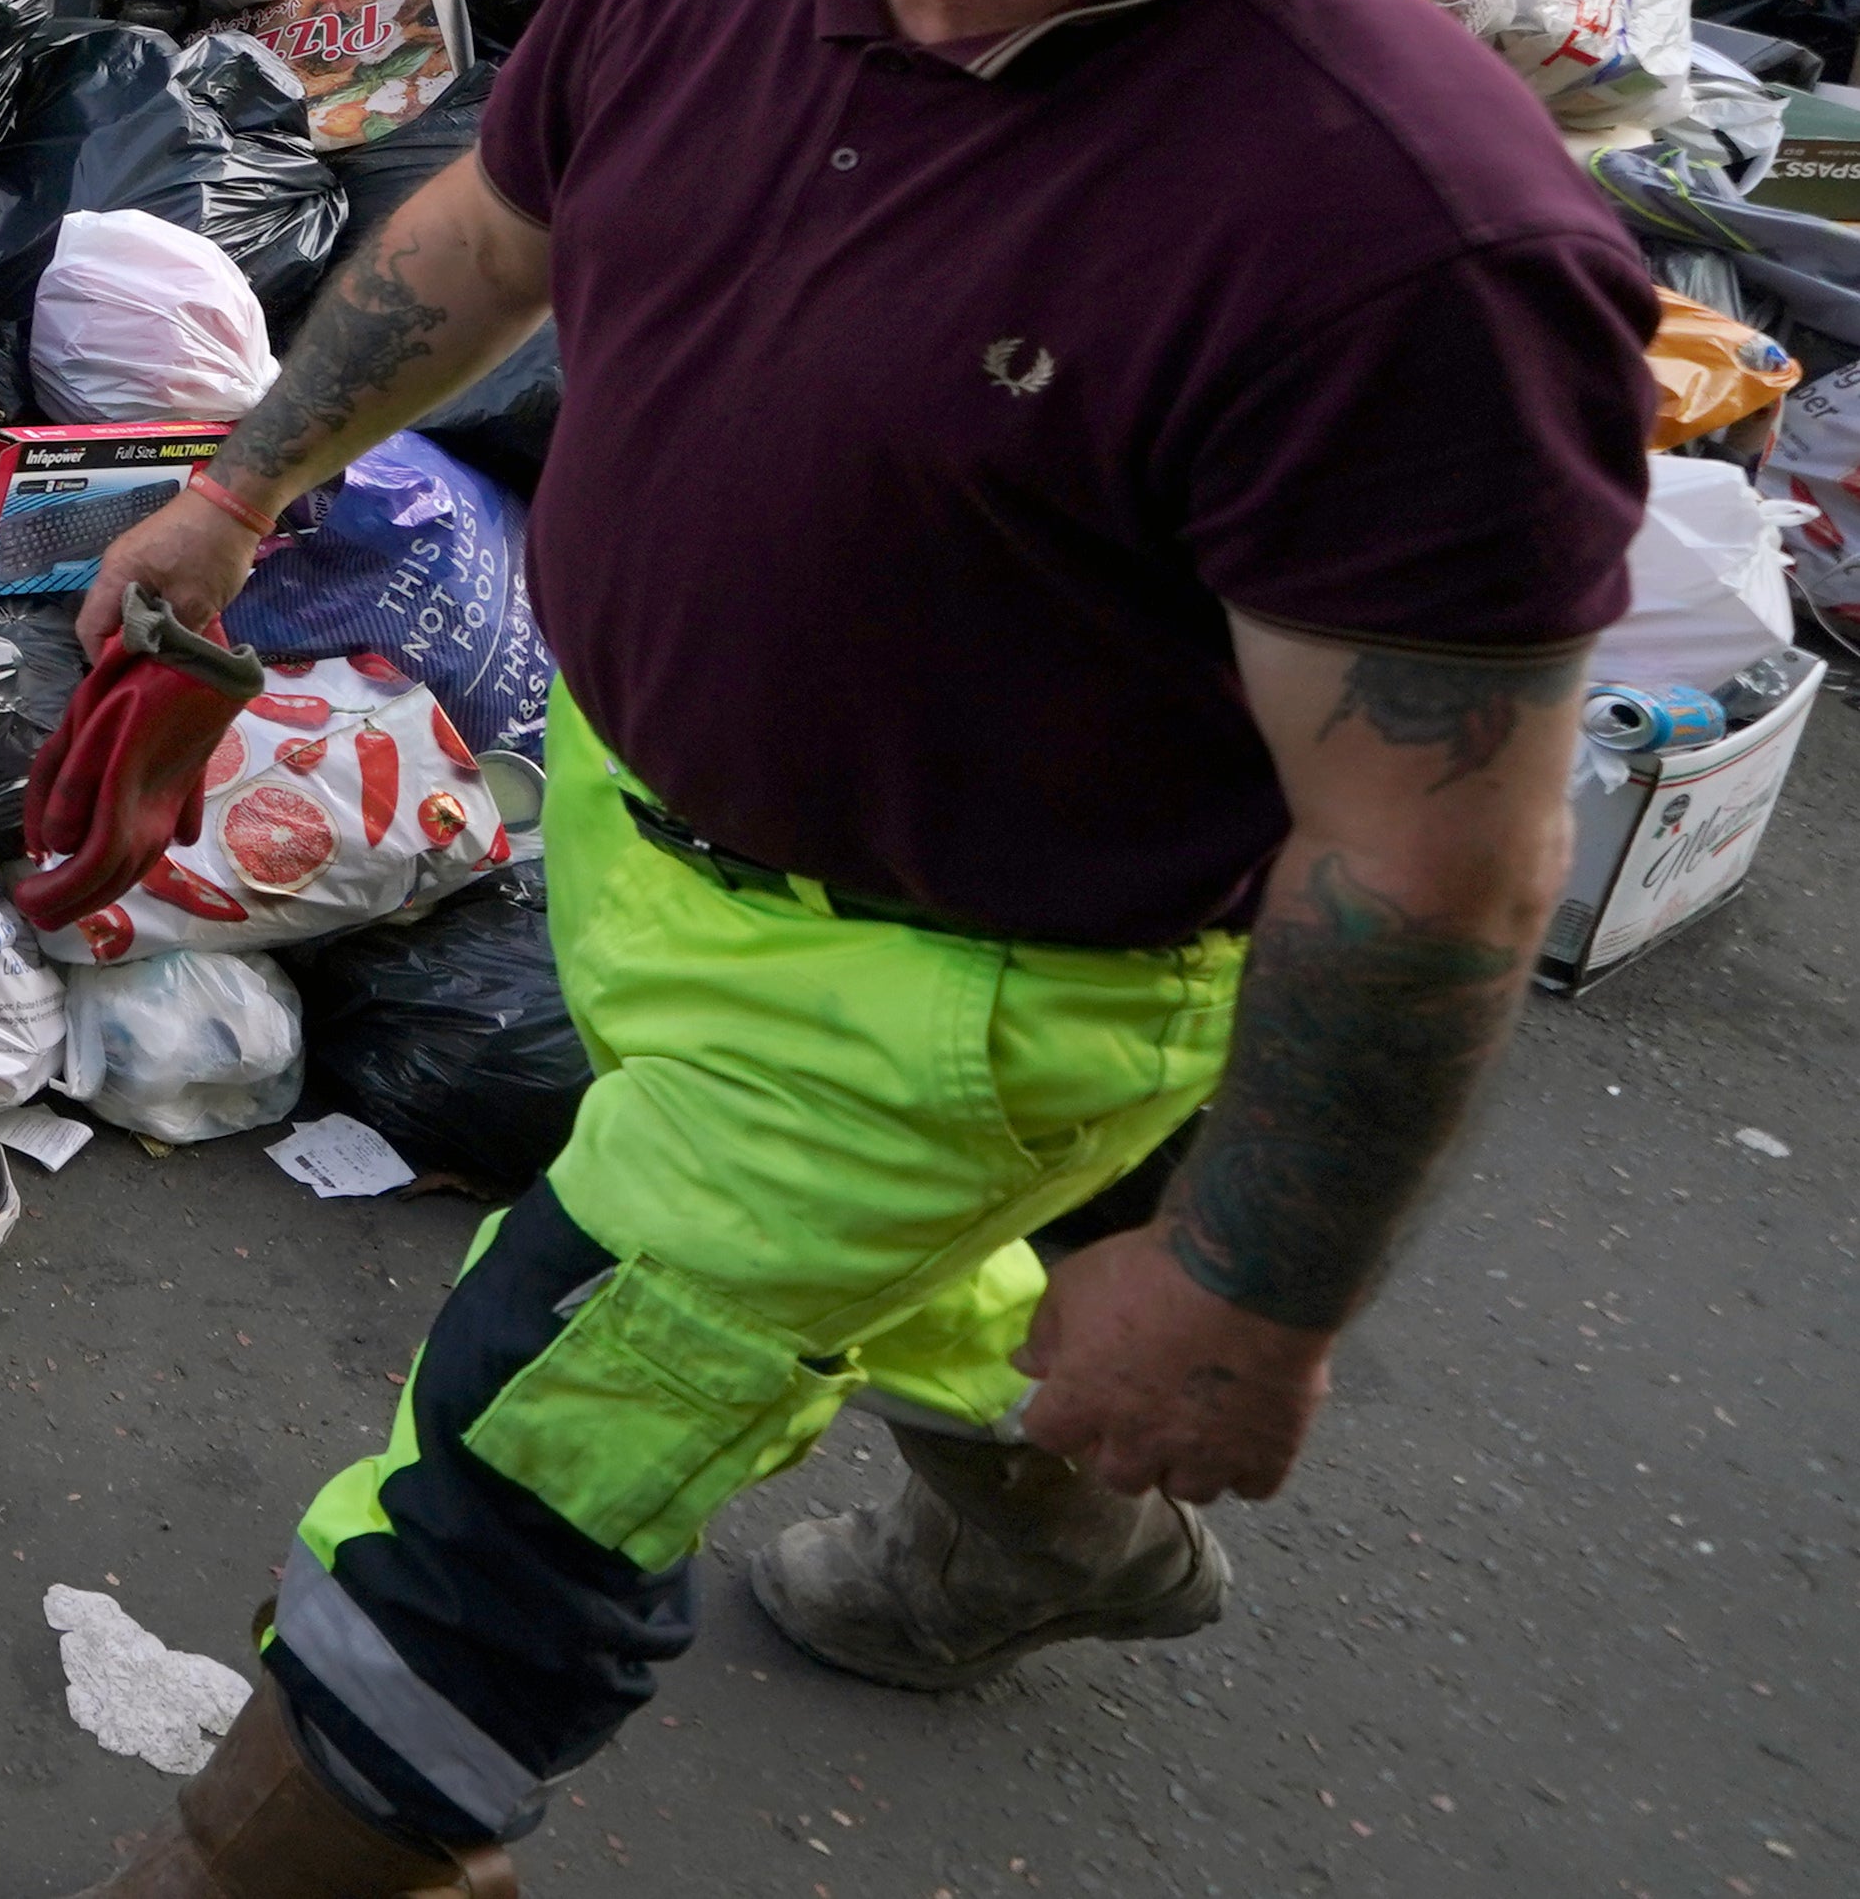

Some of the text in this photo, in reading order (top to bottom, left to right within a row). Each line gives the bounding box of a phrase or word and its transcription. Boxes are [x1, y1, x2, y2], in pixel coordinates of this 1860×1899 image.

[25, 447, 87, 468] Infapower
[114, 446, 135, 460] Full
[377, 499, 458, 615] THIS IS
[401, 491, 477, 663] NOT JUST
[451, 548, 495, 651] FOOD
[493, 614, 531, 697] THIS
[497, 673, 548, 749] M&S
